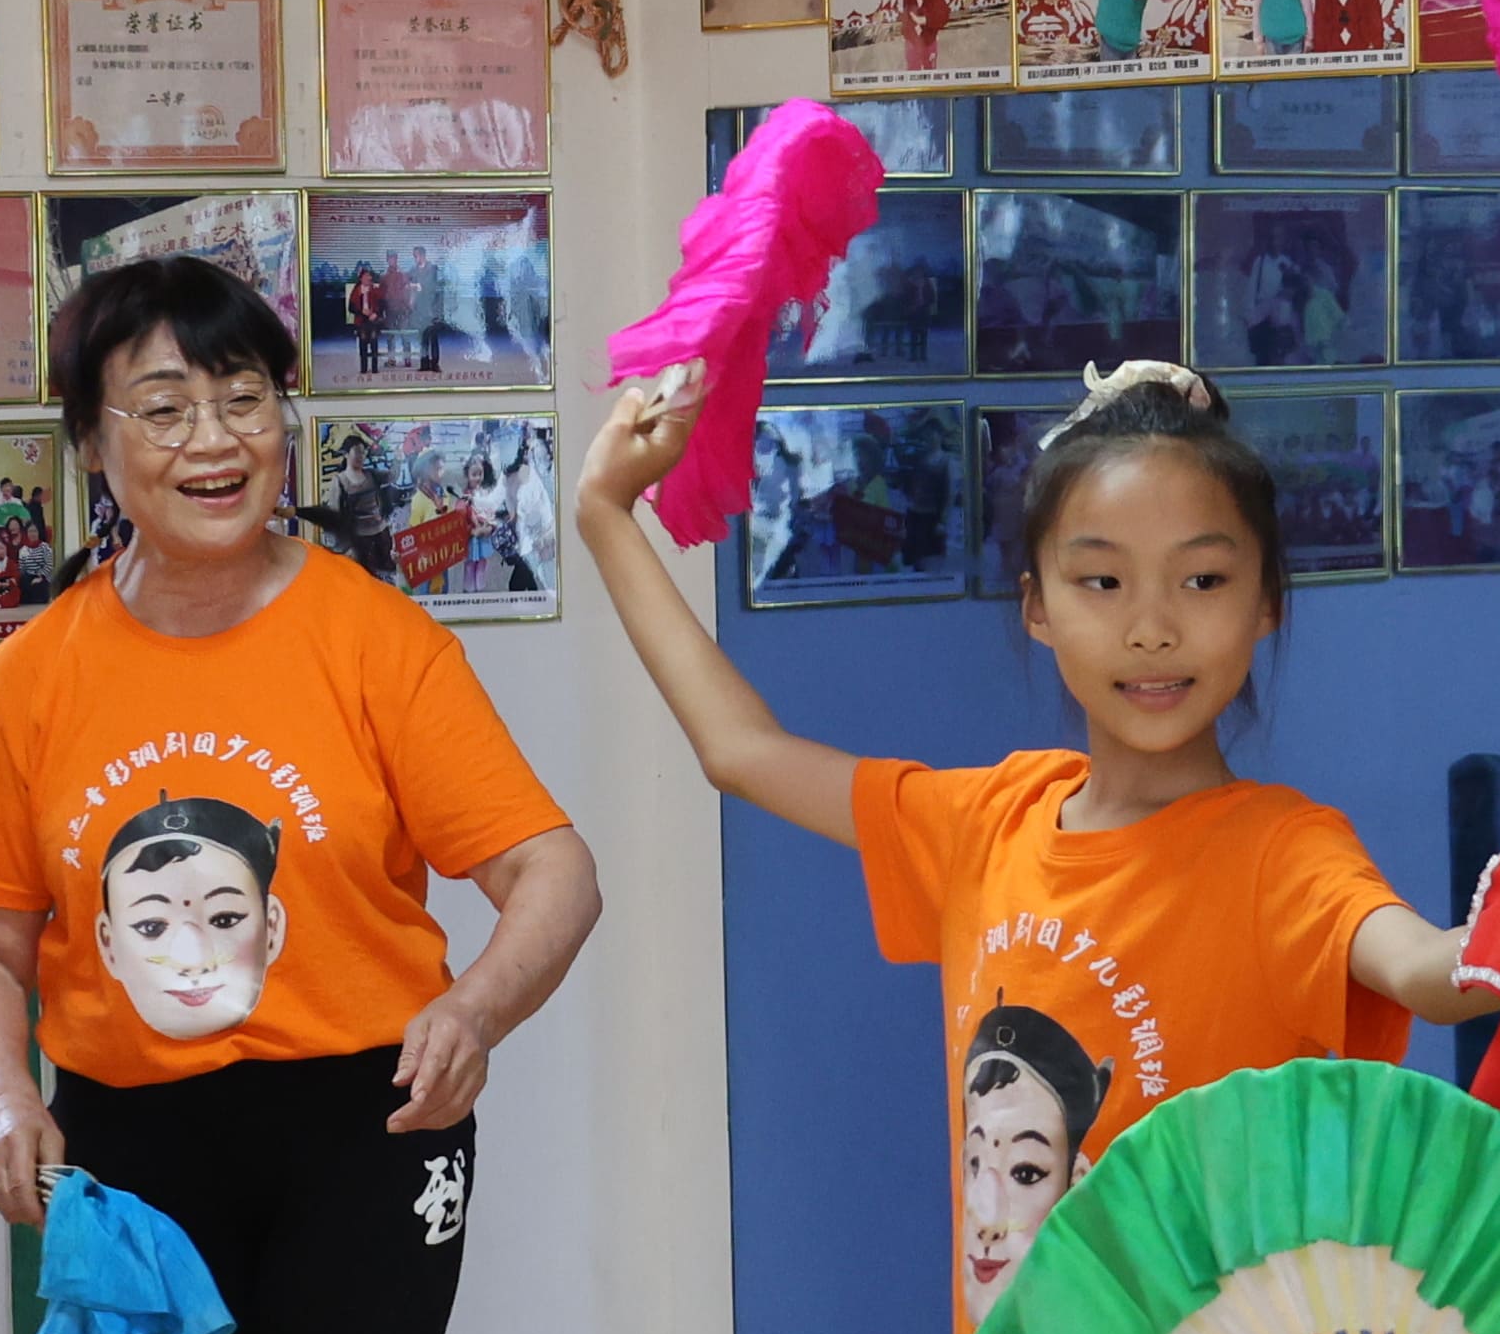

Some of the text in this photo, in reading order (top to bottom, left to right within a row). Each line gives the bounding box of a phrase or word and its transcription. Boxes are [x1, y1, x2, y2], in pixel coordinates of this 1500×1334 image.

[125, 11, 204, 34] 荣誉证书
[407, 15, 471, 33] 荣誉证书
